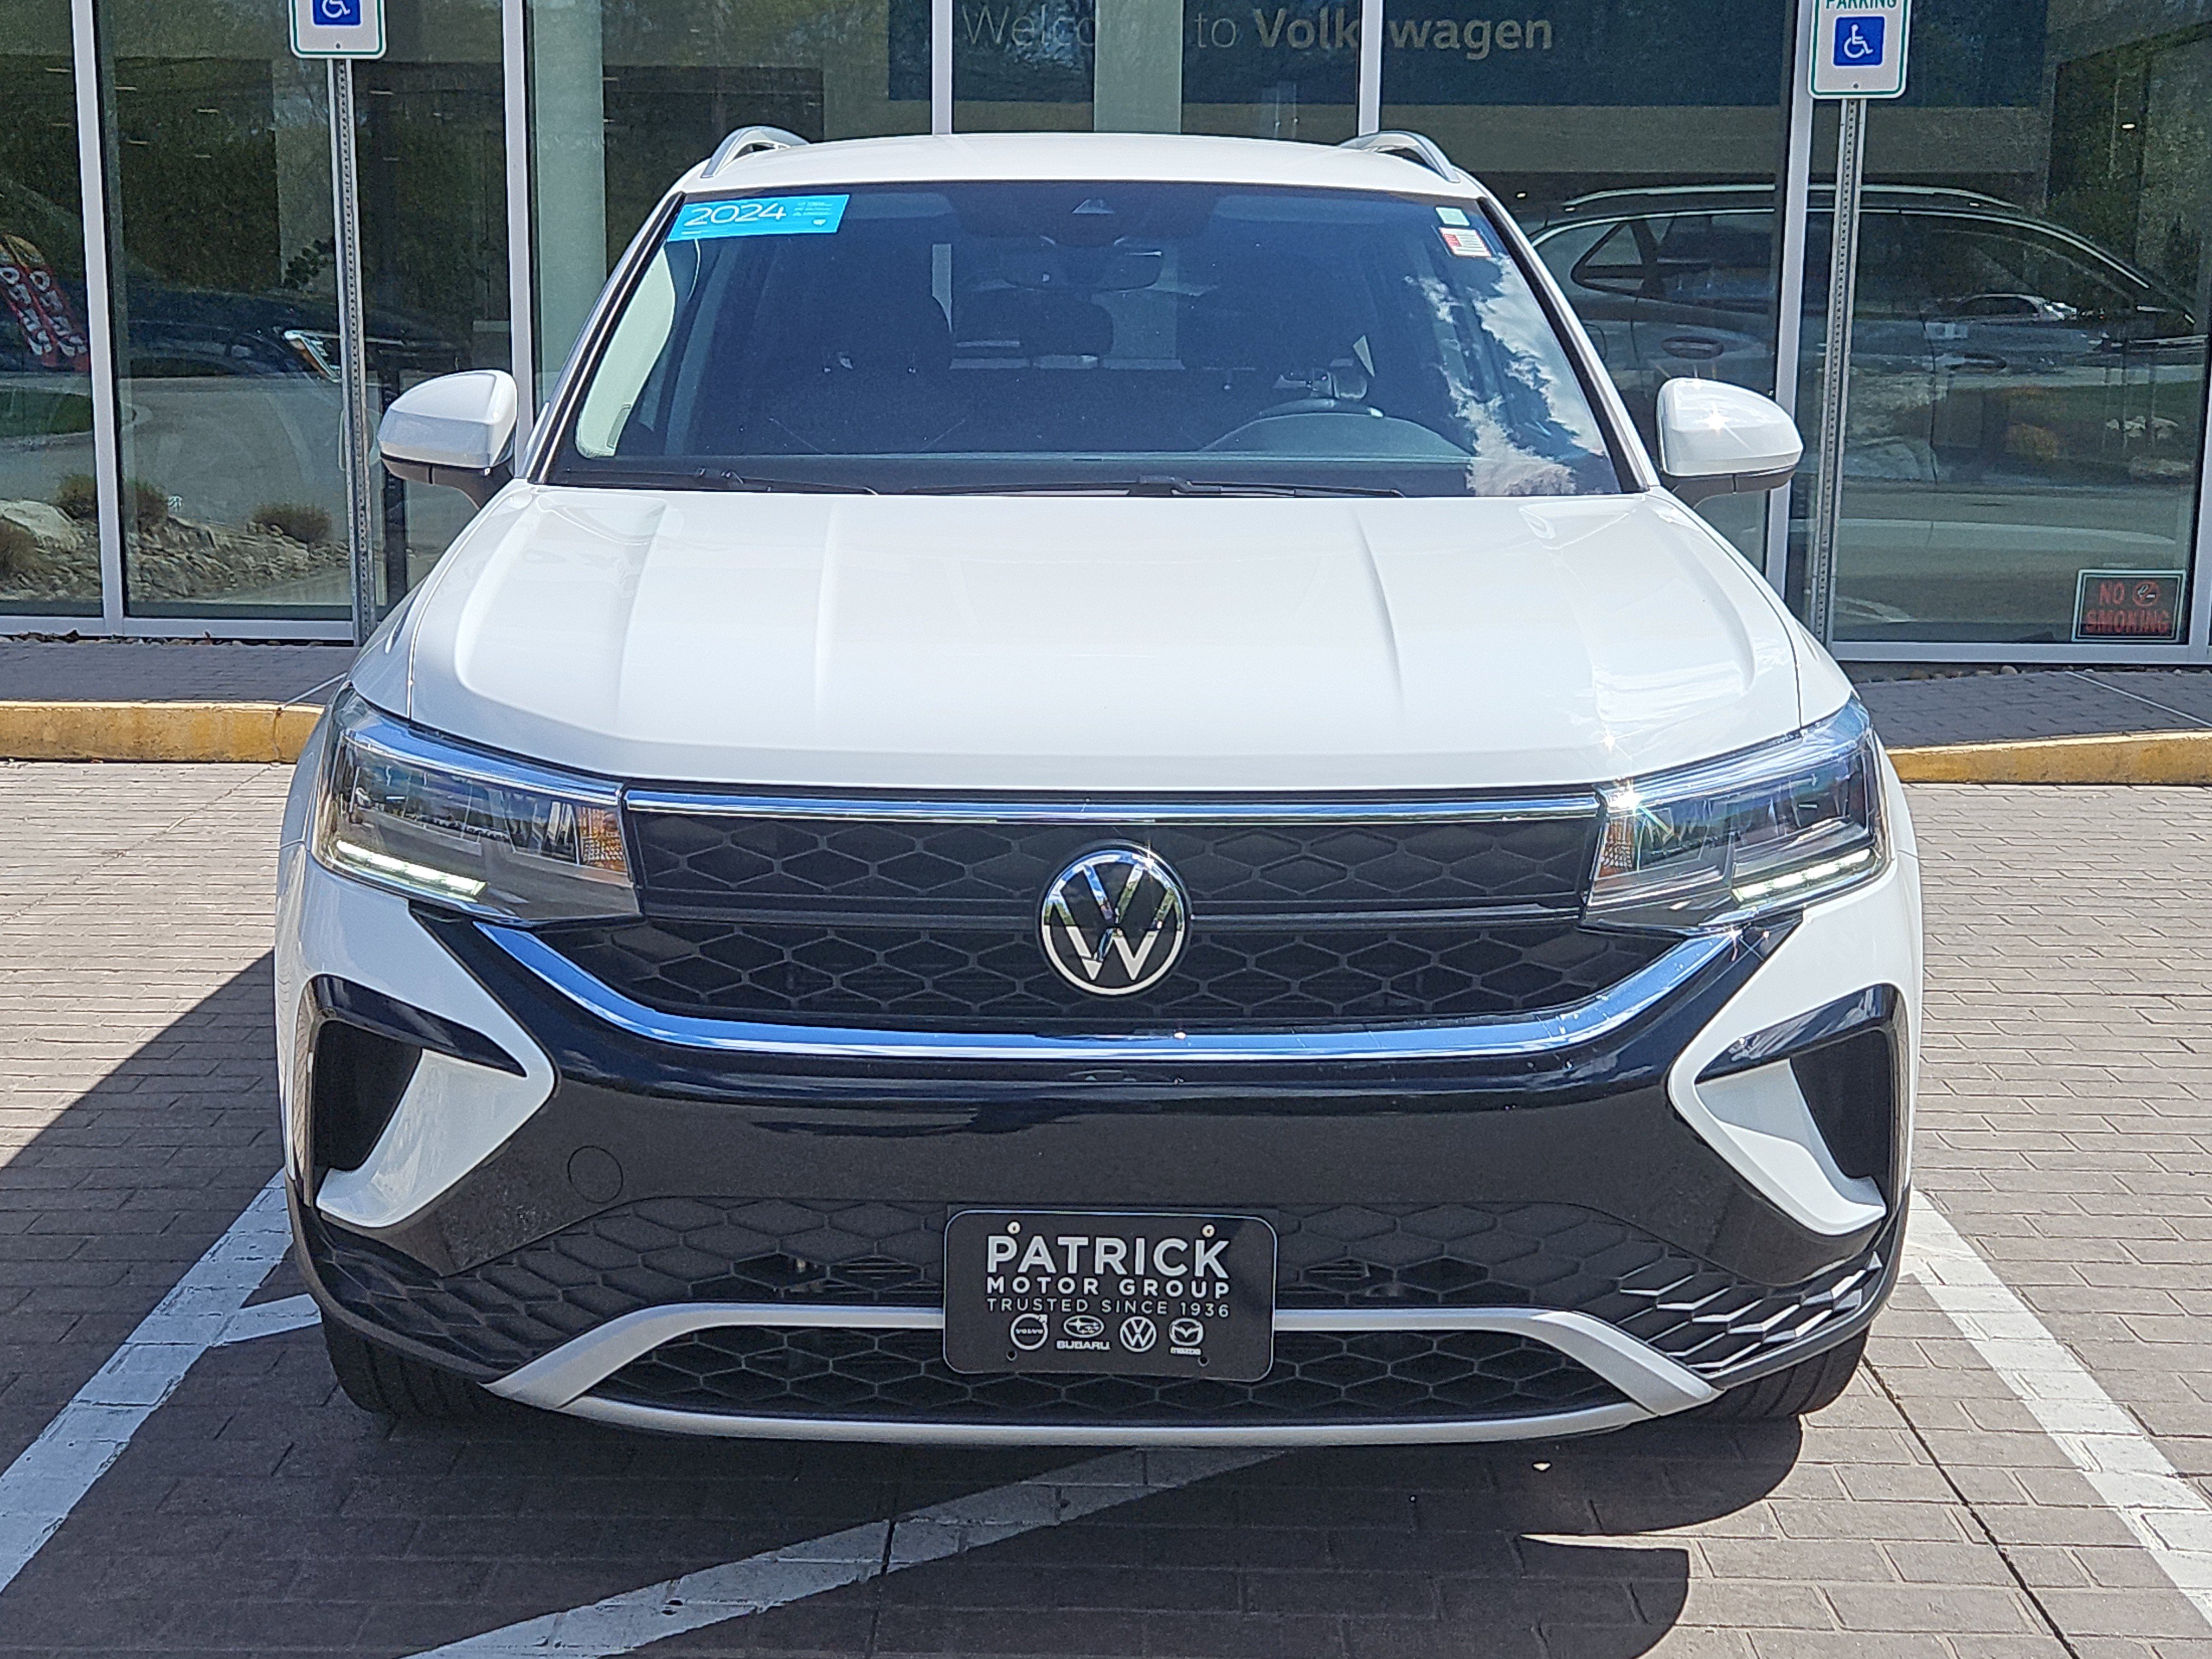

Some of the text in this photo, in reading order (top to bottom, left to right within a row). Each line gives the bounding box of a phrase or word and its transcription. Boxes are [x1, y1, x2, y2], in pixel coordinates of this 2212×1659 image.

[962, 4, 1552, 60] Welco to Volkwagen
[683, 202, 786, 226] 2024
[2099, 580, 2125, 606] NO
[2085, 609, 2171, 633] SMOKING
[987, 1235, 1231, 1279] PATRICK
[986, 1276, 1230, 1299] MOTOR GROUP
[986, 1298, 1230, 1318] TRUSTED SINCE 1936
[1056, 1340, 1111, 1351] SUBARU
